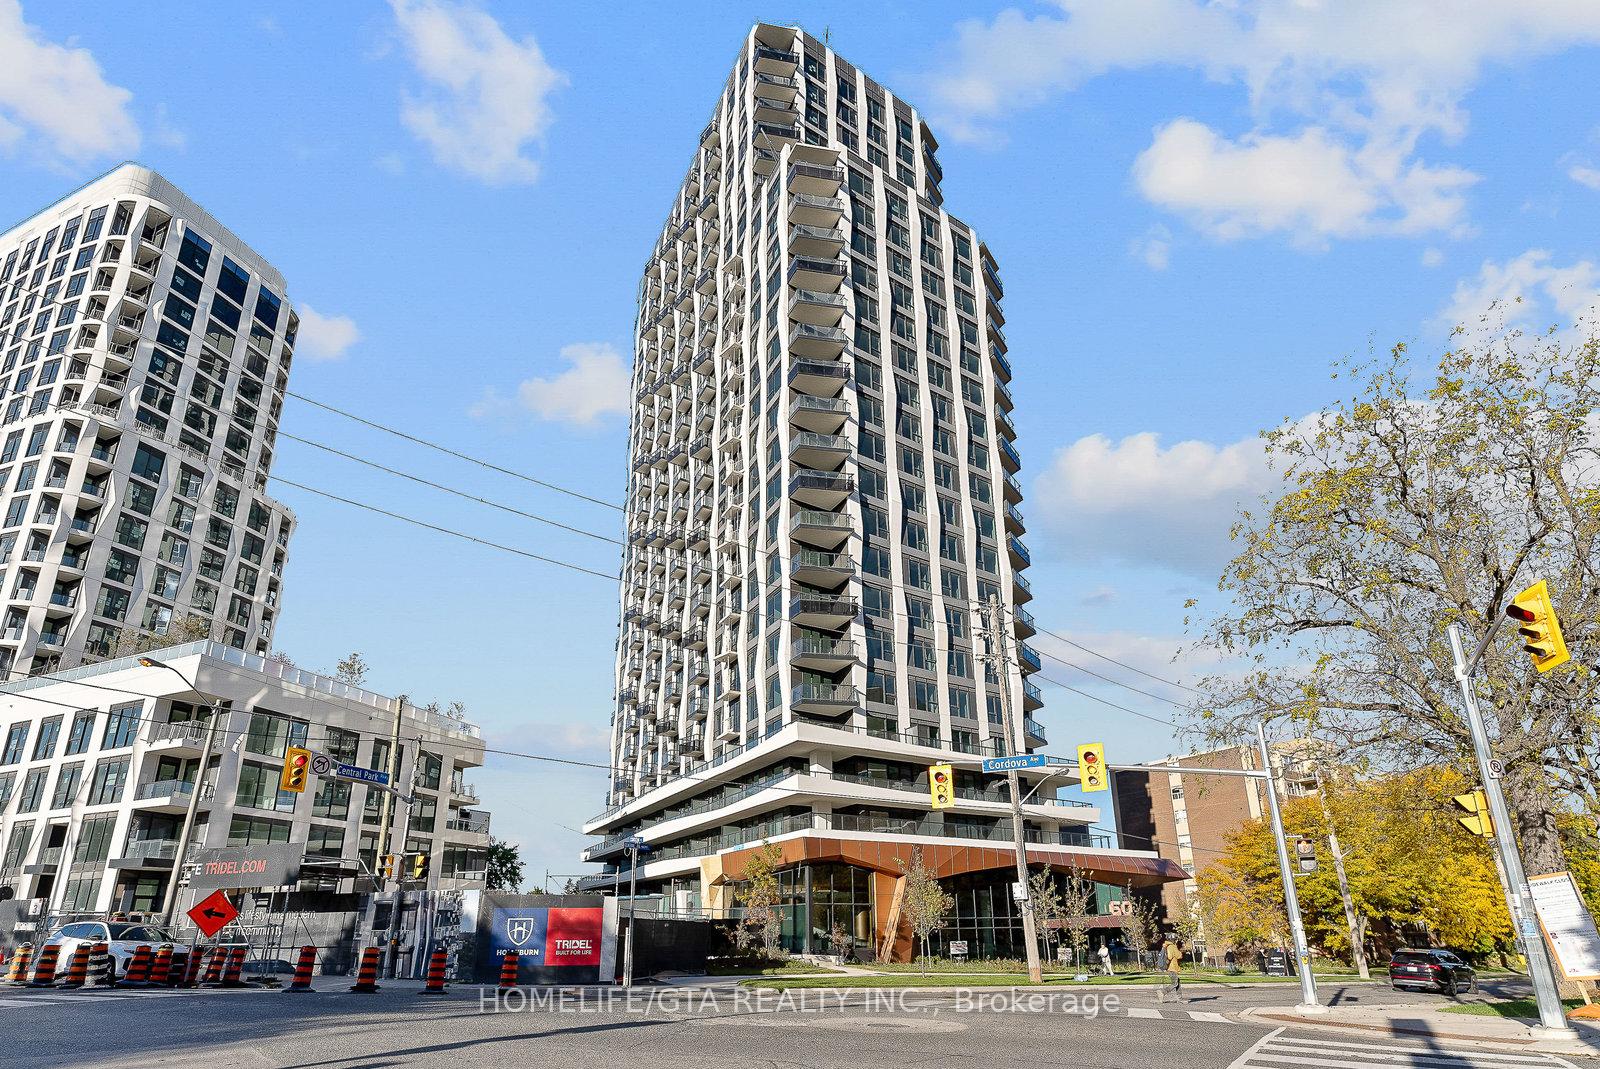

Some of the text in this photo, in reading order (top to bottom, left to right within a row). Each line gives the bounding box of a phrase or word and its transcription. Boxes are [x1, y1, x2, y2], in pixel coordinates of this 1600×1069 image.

[988, 759, 1028, 769] Cordova
[337, 765, 362, 778] Central
[364, 770, 379, 781] Park
[204, 860, 267, 874] TRIDEL.COM
[555, 939, 592, 949] TRIDEL
